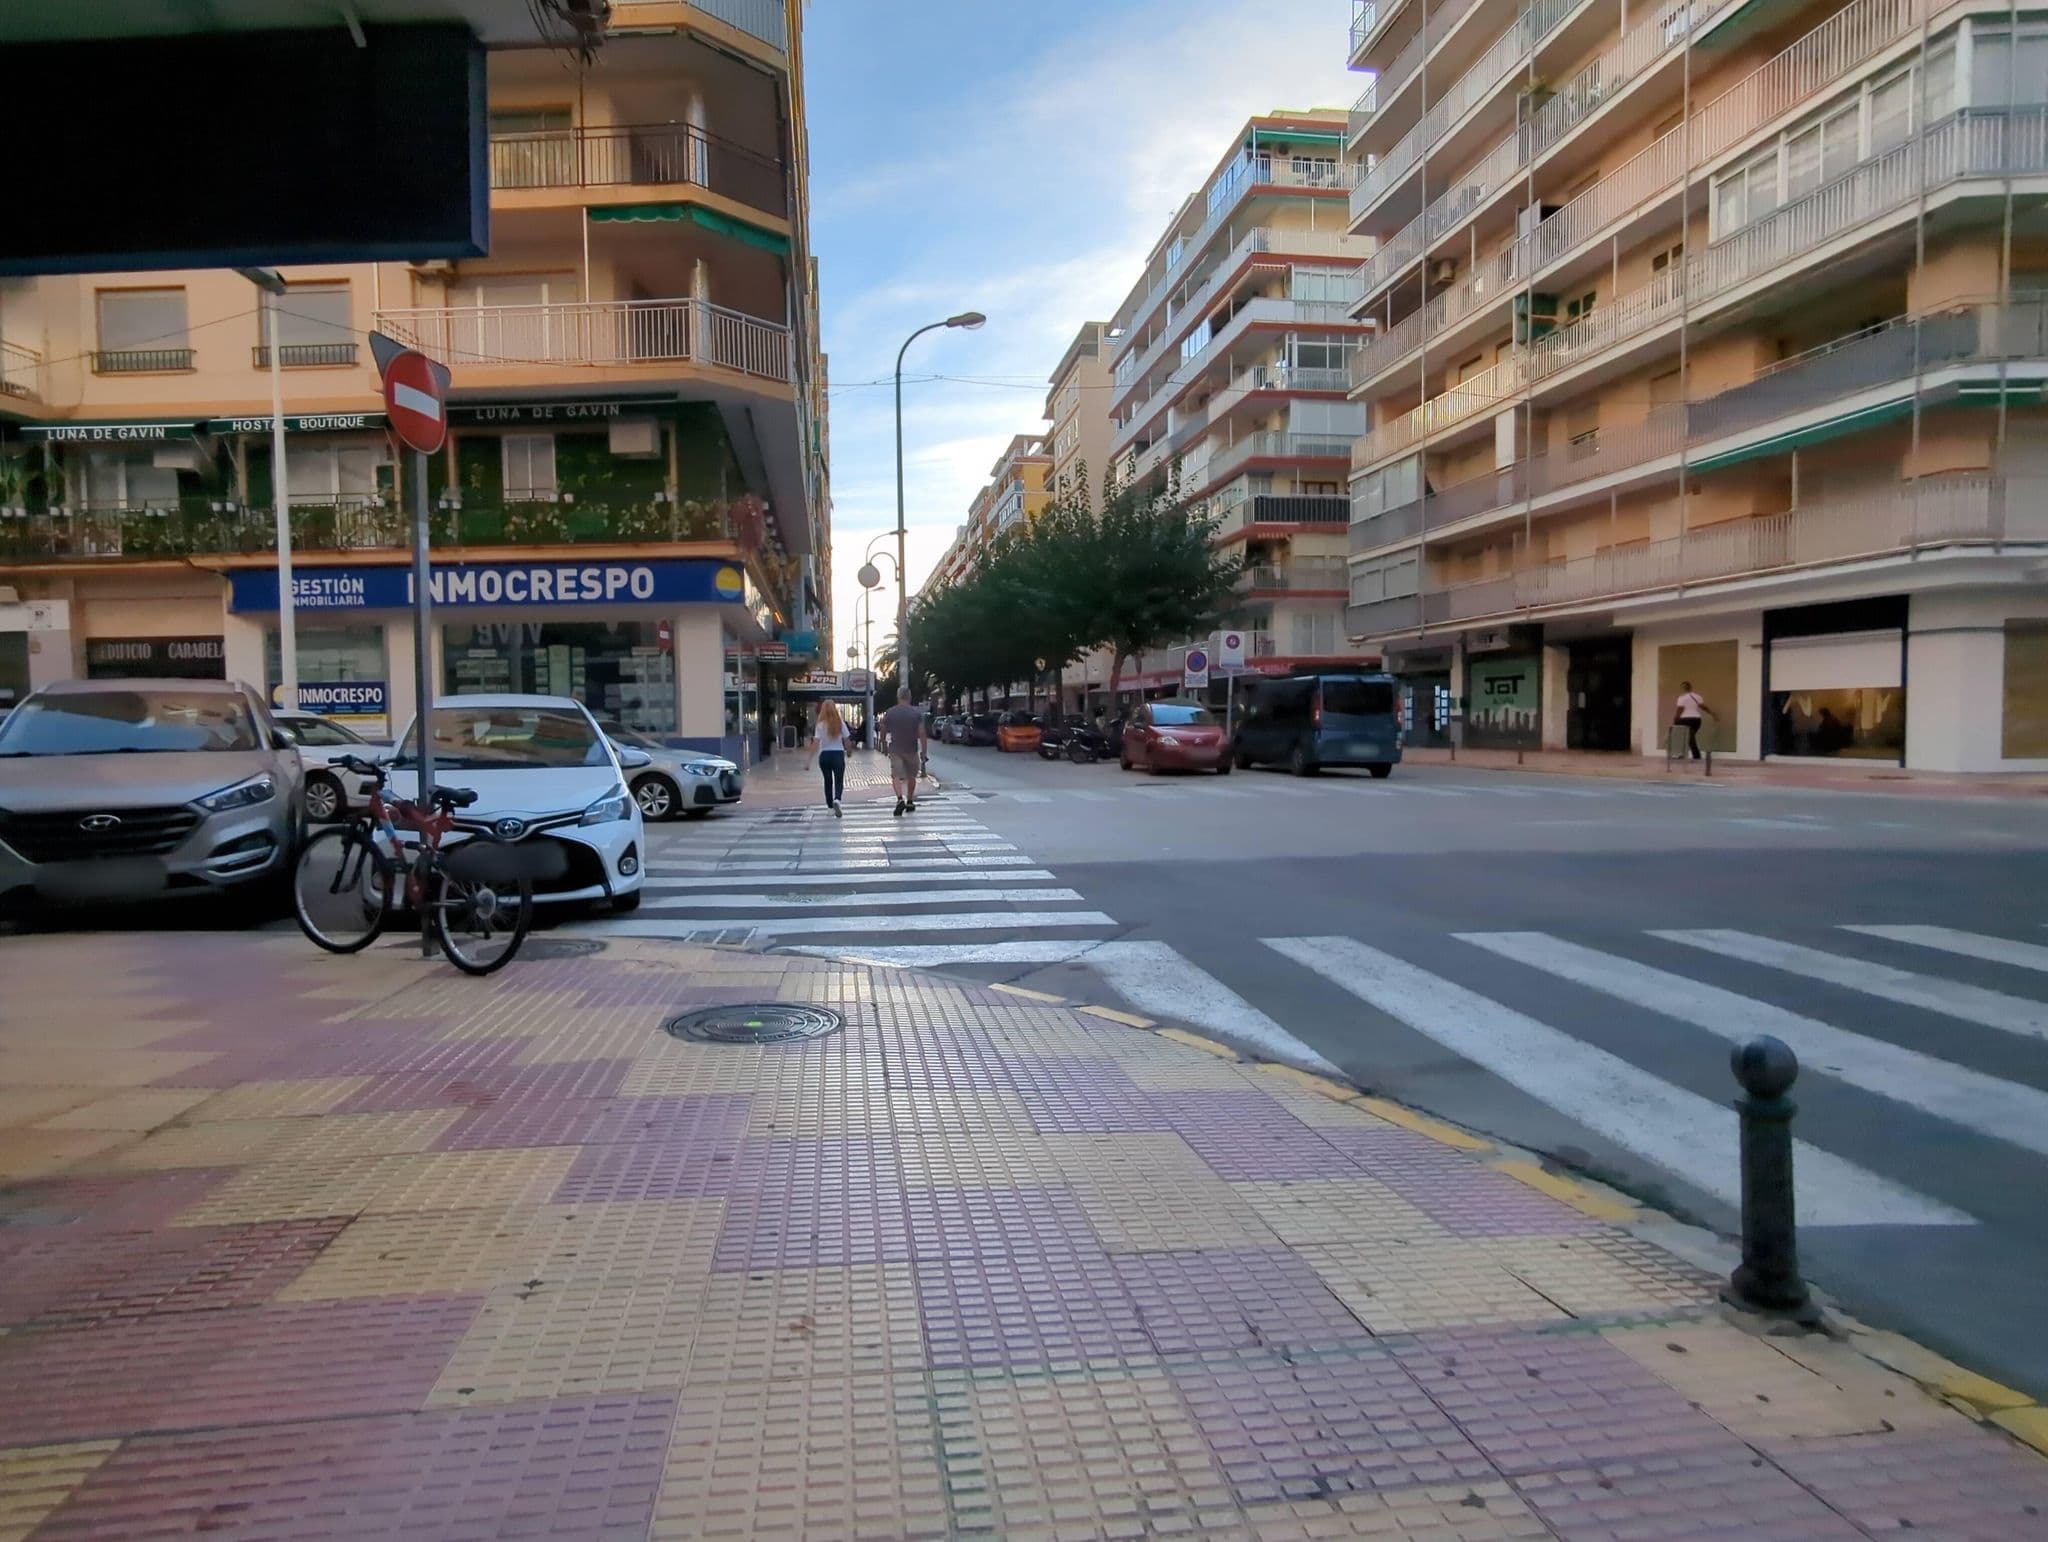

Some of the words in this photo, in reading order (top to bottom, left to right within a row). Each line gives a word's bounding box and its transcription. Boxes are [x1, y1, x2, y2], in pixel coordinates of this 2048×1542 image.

[475, 406, 520, 419] LUNA
[532, 406, 553, 418] DE
[566, 404, 620, 416] GAVIN
[232, 420, 289, 431] HOSTL
[300, 416, 365, 429] BOUTIQUE
[47, 429, 88, 440] LUNA
[93, 429, 113, 439] DE
[118, 427, 165, 438] GAVIN
[291, 573, 364, 595] GESTIÓN
[407, 567, 655, 603] INMOCRESPO
[292, 595, 365, 606] NMOBILIARIA
[299, 688, 382, 703] INMOCRESPO
